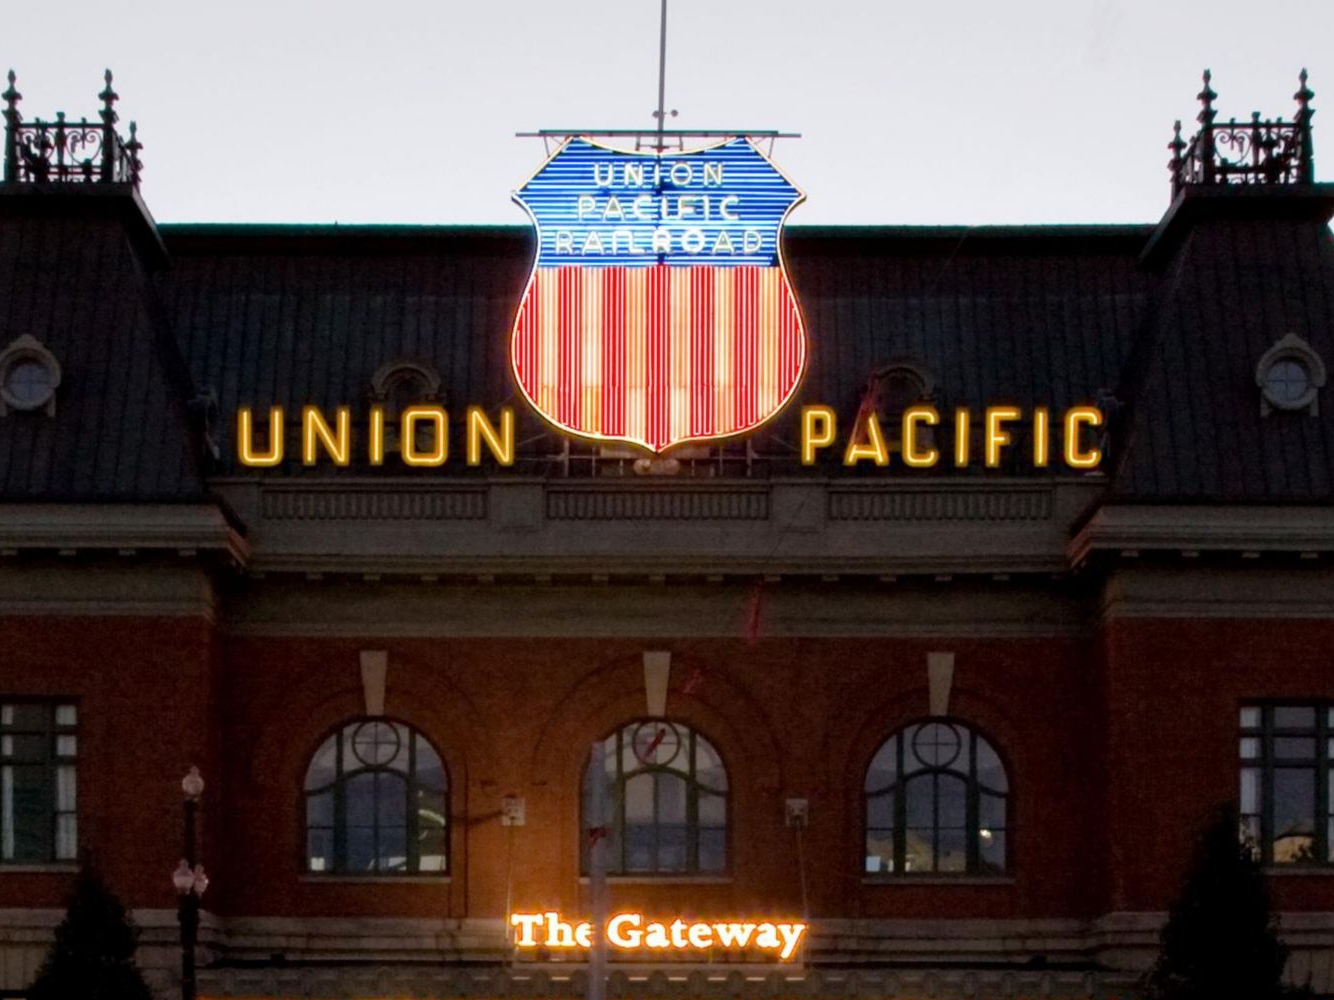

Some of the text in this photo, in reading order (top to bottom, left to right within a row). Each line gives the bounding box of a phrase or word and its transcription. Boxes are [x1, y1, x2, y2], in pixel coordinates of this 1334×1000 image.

[593, 162, 724, 186] UNION
[577, 195, 740, 221] PACIFIC
[555, 230, 763, 255] RAILROAD
[238, 404, 1103, 468] UNION PACIFIC
[510, 911, 806, 959] The Gateway
